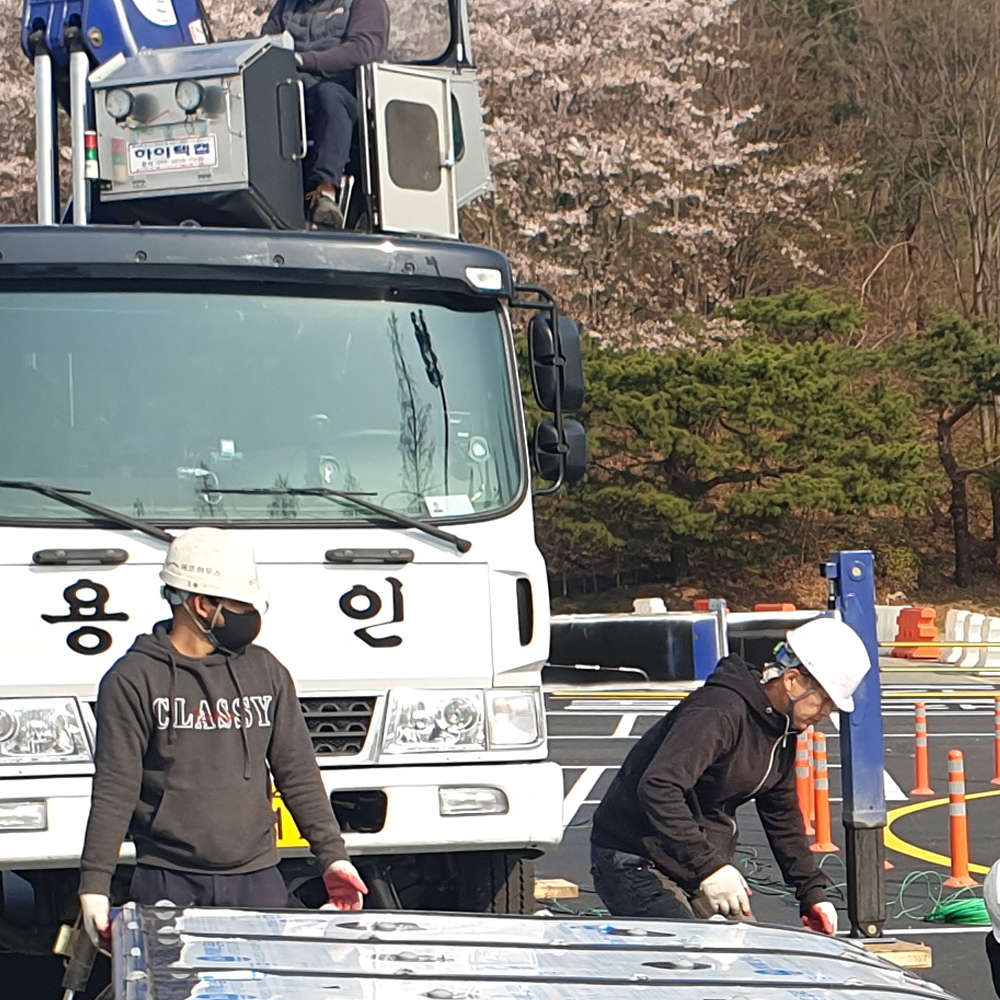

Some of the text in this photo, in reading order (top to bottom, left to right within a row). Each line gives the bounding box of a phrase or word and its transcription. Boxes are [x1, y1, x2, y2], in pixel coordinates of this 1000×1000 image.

[40, 577, 404, 656] 용 인
[152, 695, 273, 730] CLASSY
